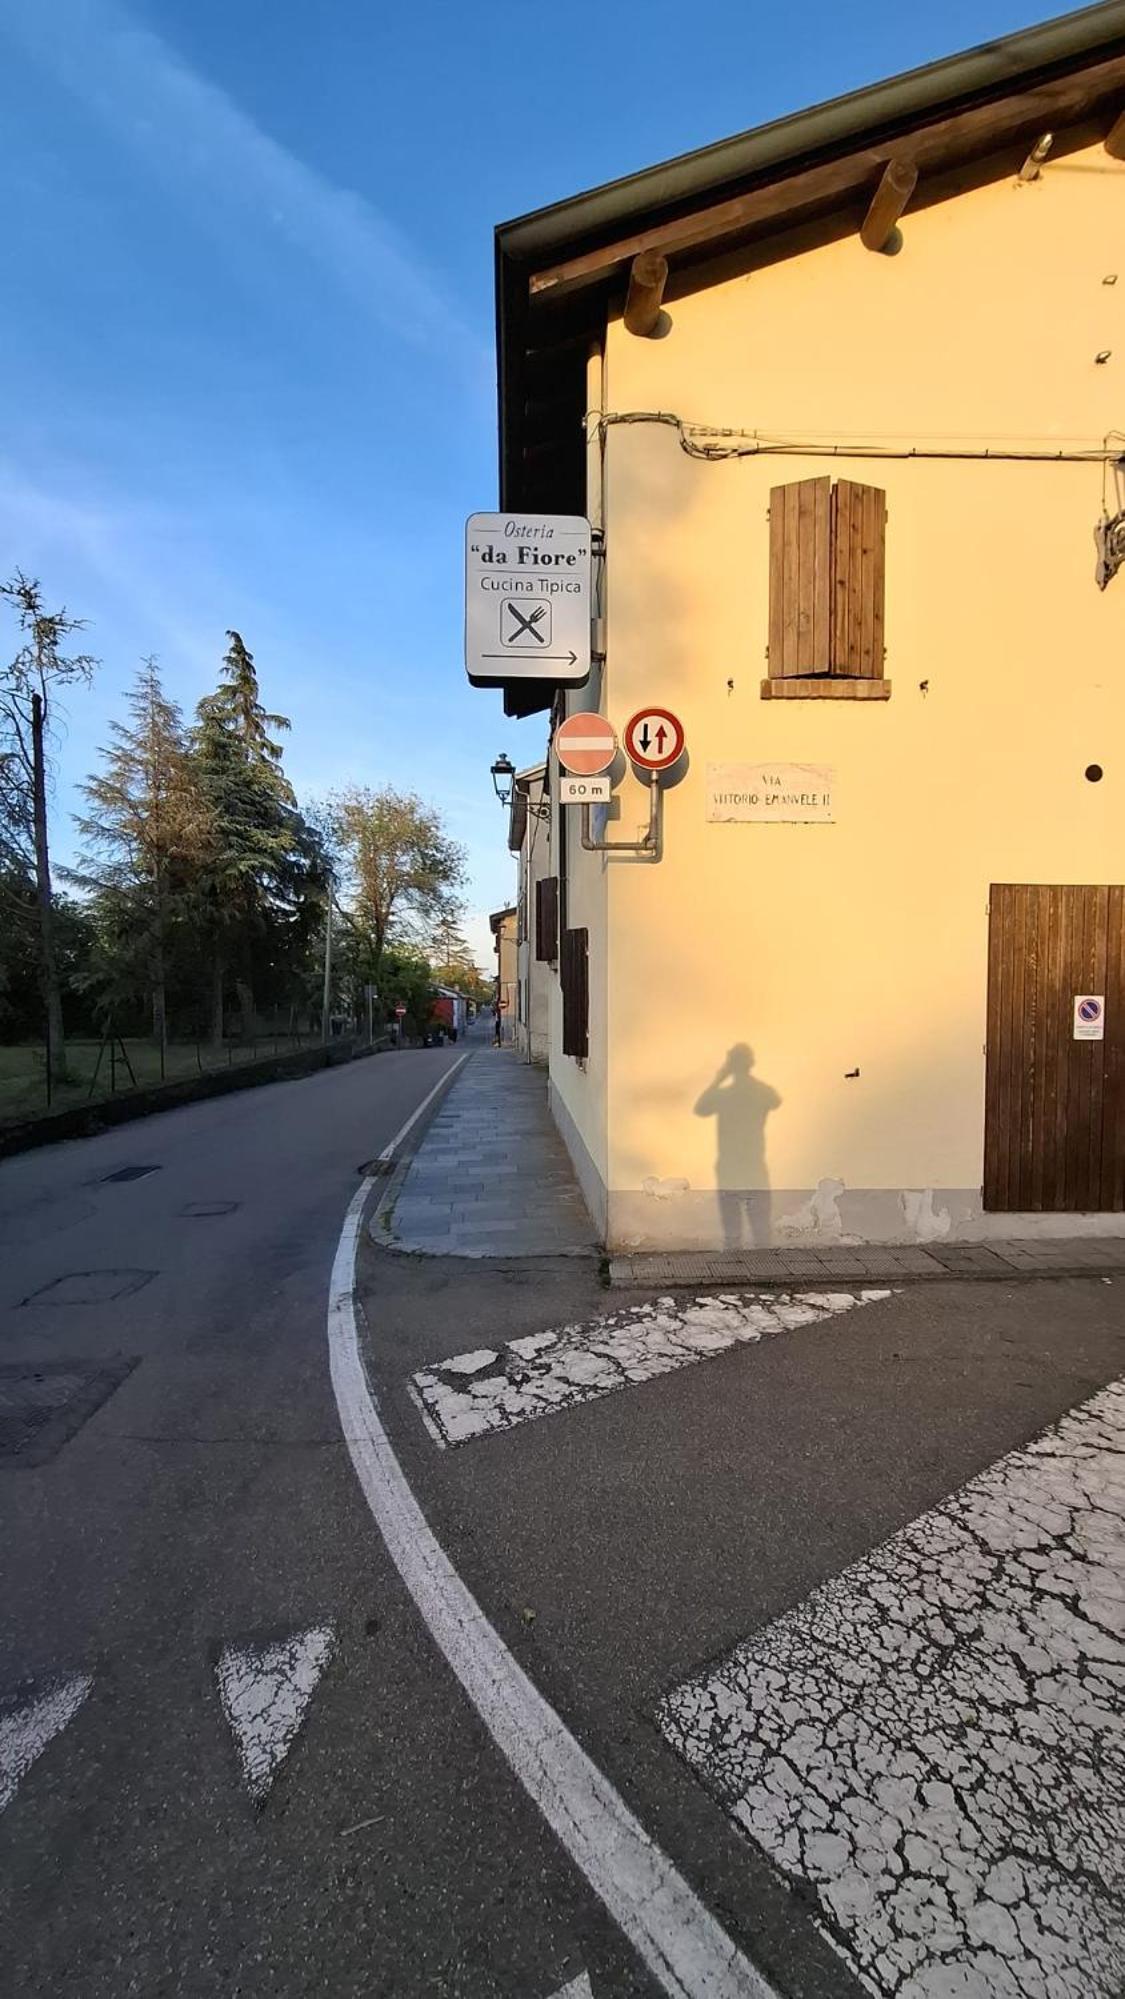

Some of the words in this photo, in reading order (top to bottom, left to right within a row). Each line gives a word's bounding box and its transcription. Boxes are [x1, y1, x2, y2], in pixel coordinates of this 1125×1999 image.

[504, 520, 554, 538] Osteria
[480, 576, 534, 591] Cucina
[538, 578, 581, 595] Tipica
[761, 774, 782, 786] VIA
[568, 784, 587, 795] 60
[591, 786, 603, 795] m
